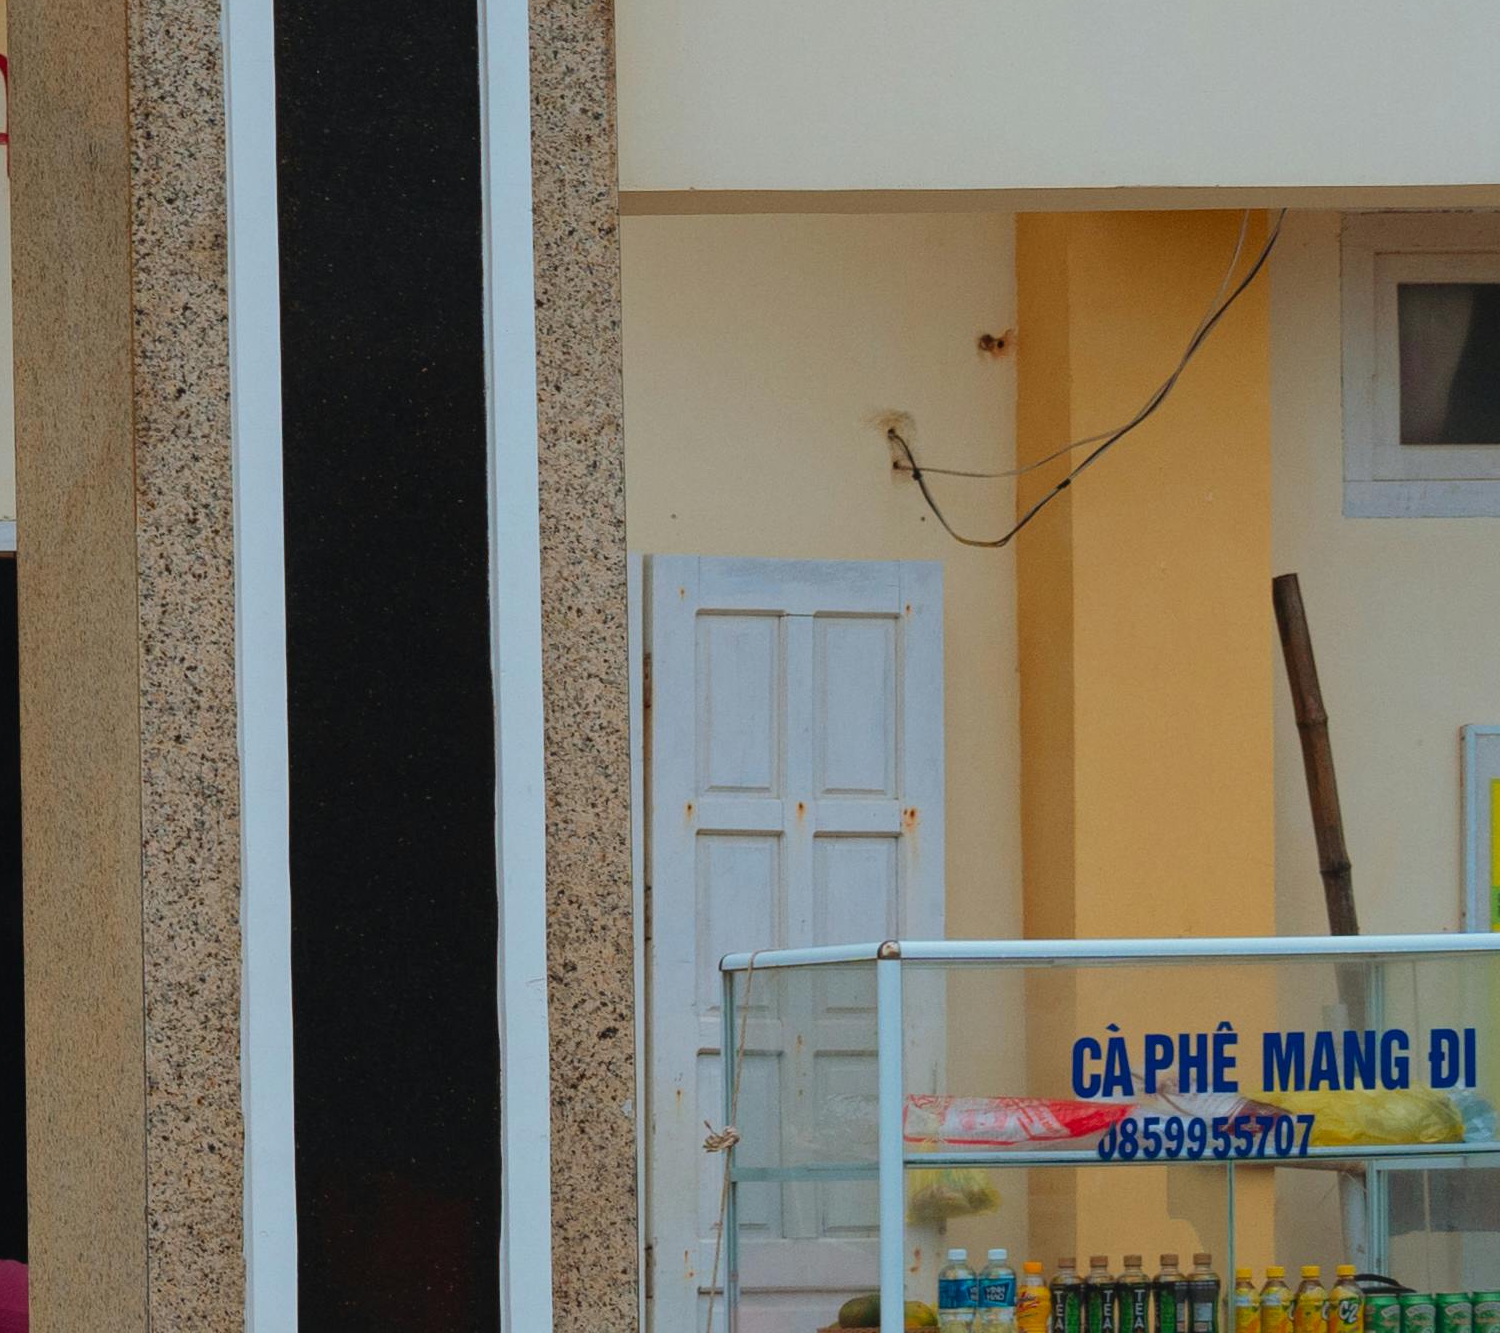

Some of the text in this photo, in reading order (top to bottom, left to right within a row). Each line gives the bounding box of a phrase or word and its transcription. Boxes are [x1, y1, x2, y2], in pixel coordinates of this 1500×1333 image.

[1072, 1021, 1477, 1098] CÀ PHÊ MANG ĐI
[1098, 1114, 1316, 1161] 0859955707
[1338, 1299, 1359, 1324] C2
